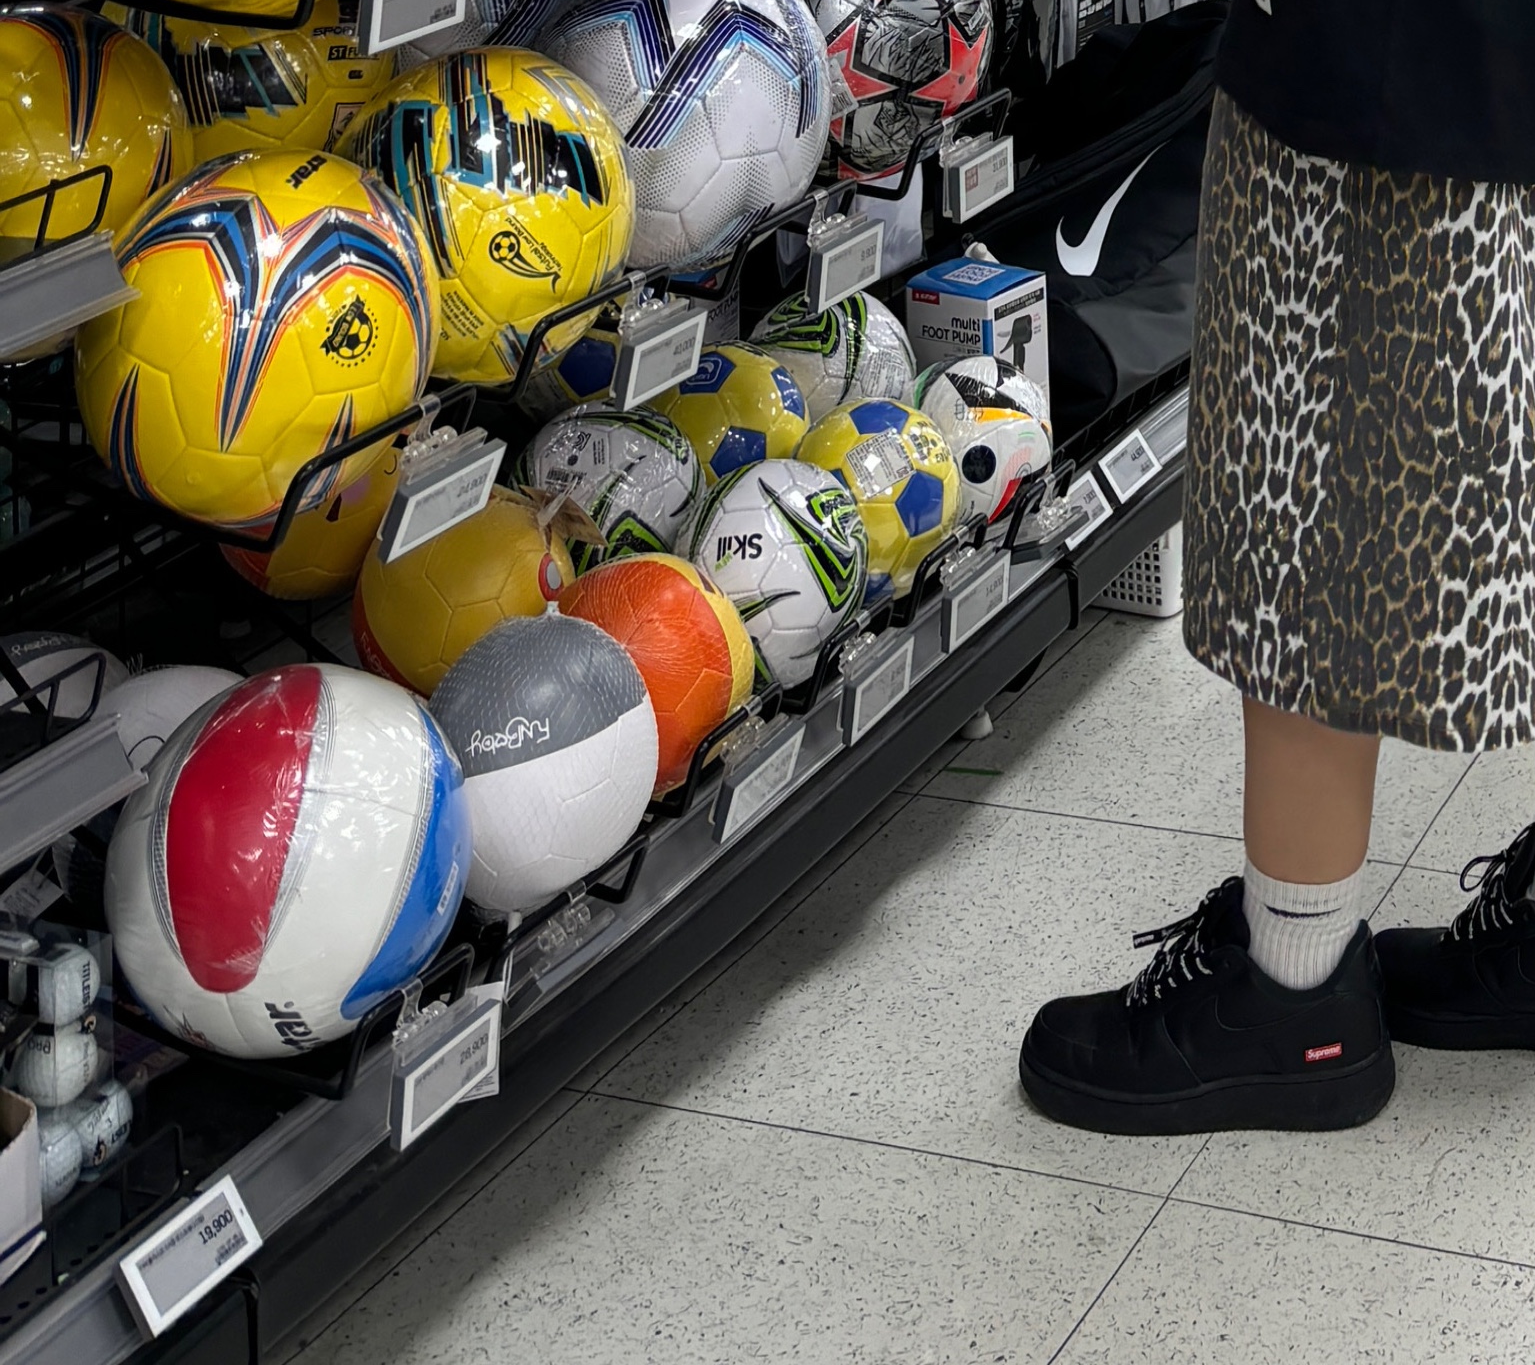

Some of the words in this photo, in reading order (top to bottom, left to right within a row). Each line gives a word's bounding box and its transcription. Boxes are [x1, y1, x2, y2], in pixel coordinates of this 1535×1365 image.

[922, 324, 949, 341] FOOT
[952, 329, 981, 346] PUMP
[950, 316, 981, 332] multi
[81, 960, 93, 1010] TITLEIST
[1307, 1045, 1342, 1061] Supreme
[197, 1207, 235, 1245] 19,900
